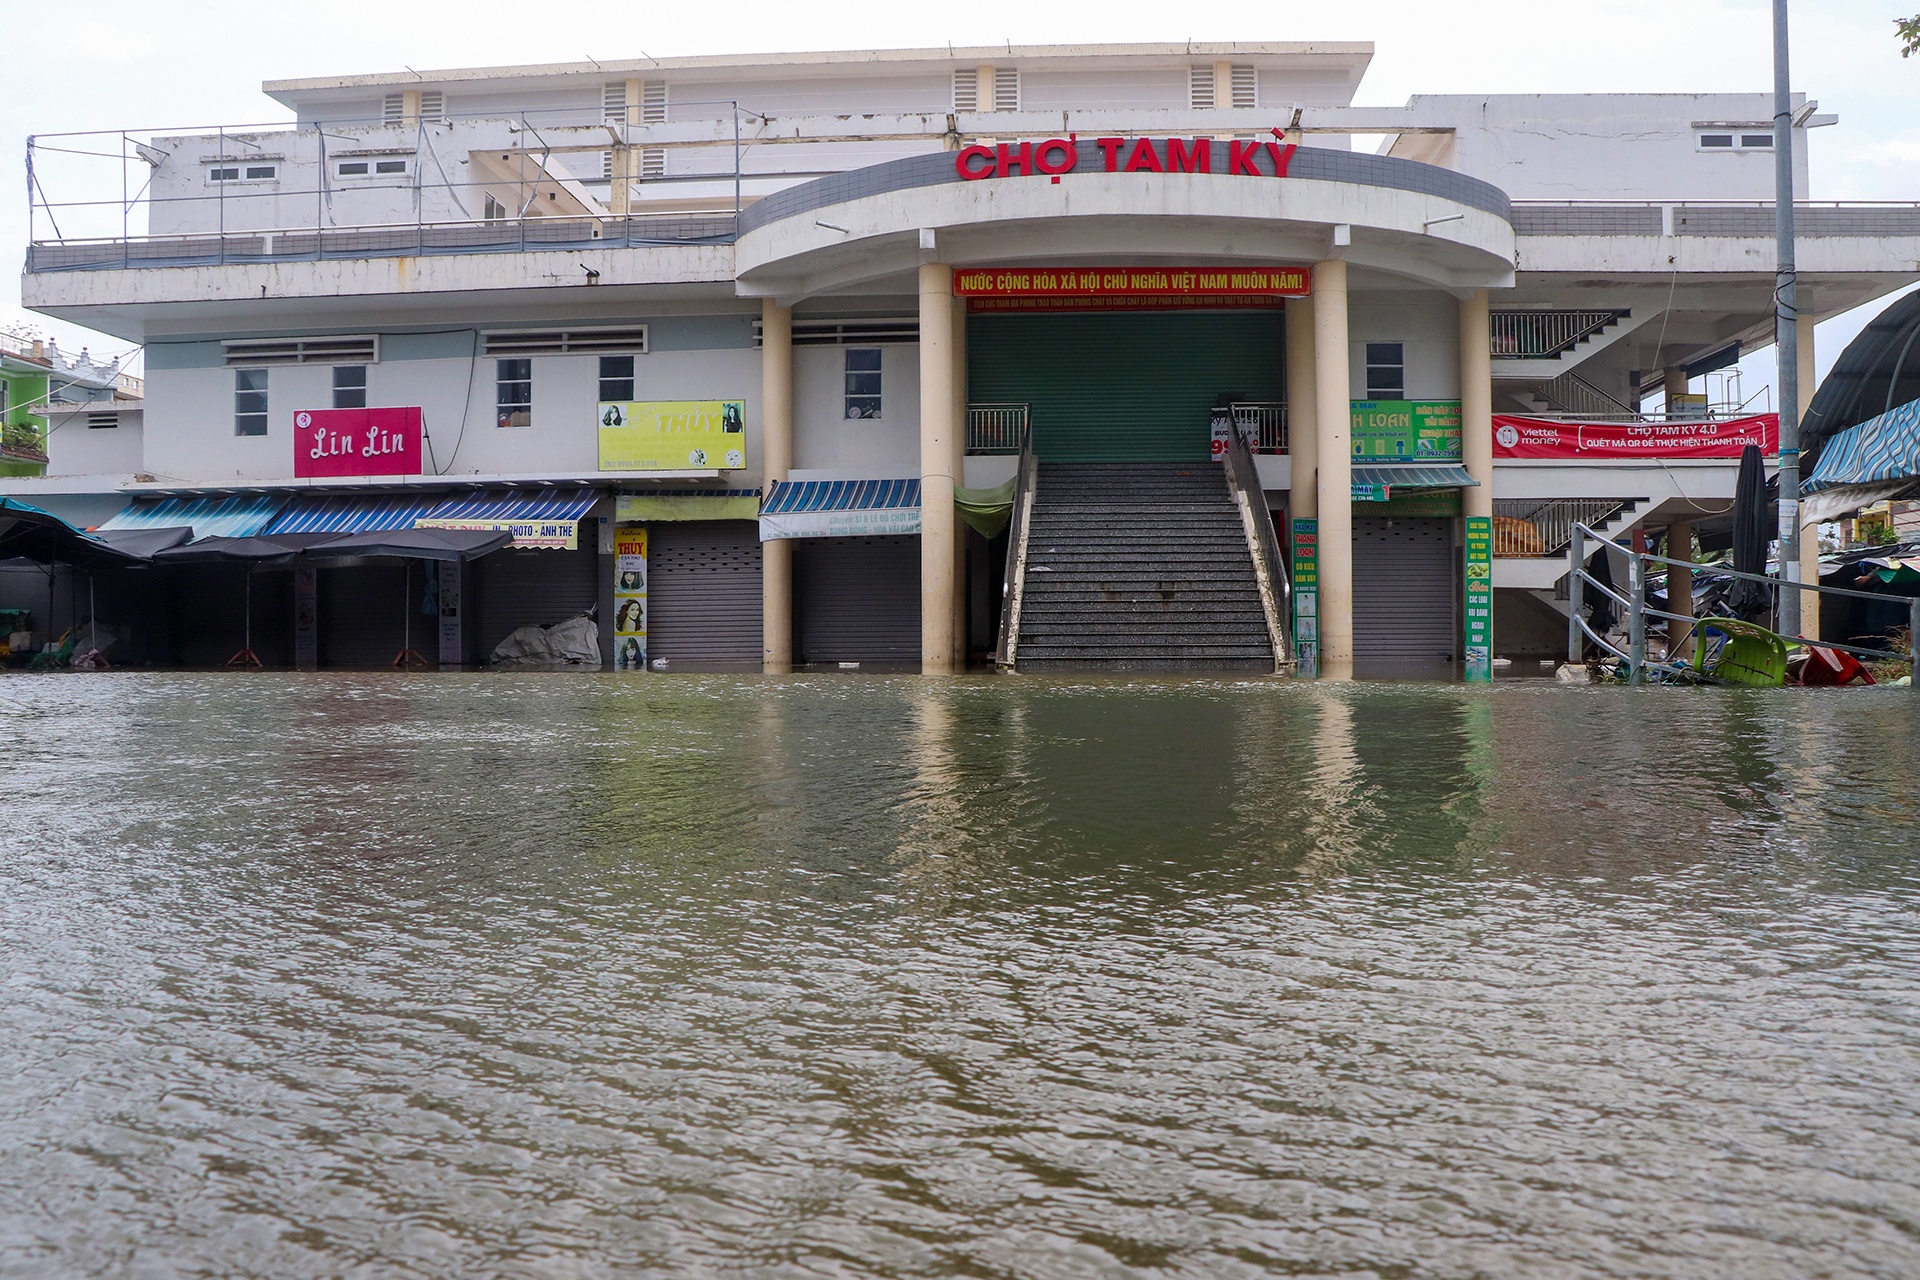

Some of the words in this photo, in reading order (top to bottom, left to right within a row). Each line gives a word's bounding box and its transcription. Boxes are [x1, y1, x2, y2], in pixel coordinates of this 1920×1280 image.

[955, 133, 1077, 184] CHỢ
[1097, 137, 1211, 174] TAM
[1230, 127, 1297, 178] KỲ
[961, 273, 994, 290] NƯỚC
[997, 272, 1030, 293] CỘNG
[1033, 272, 1057, 289] HÒA
[1060, 272, 1077, 289] XÃ
[1080, 272, 1100, 292] HỘI
[1103, 270, 1128, 289] CHỦ
[1131, 272, 1168, 289] NGHĨA
[1171, 271, 1196, 292] VIỆT
[1200, 274, 1228, 289] NAM
[1231, 272, 1267, 289] MUÔN
[1271, 271, 1303, 289] NĂM!
[1369, 413, 1410, 429] LOAN
[1521, 429, 1559, 437] viettel
[1654, 426, 1679, 435] TAM
[1699, 424, 1717, 435] 4.0
[310, 427, 353, 459] Lin
[362, 426, 404, 458] Lin
[1521, 437, 1561, 446] money
[1586, 437, 1611, 447] QUÉT
[1612, 438, 1627, 447] MÃ
[1627, 439, 1641, 447] QR
[1642, 435, 1654, 447] ĐỂ
[1655, 438, 1679, 448] THỰC
[1679, 437, 1700, 447] HIỆN
[1702, 438, 1732, 446] THANH
[1732, 435, 1758, 446] TOÁN
[1357, 485, 1373, 495] MAY
[539, 522, 557, 537] ẢNH
[559, 522, 573, 537] THẺ
[1295, 534, 1316, 544] THANH
[618, 538, 644, 554] THỦY
[1296, 547, 1314, 557] LOAN
